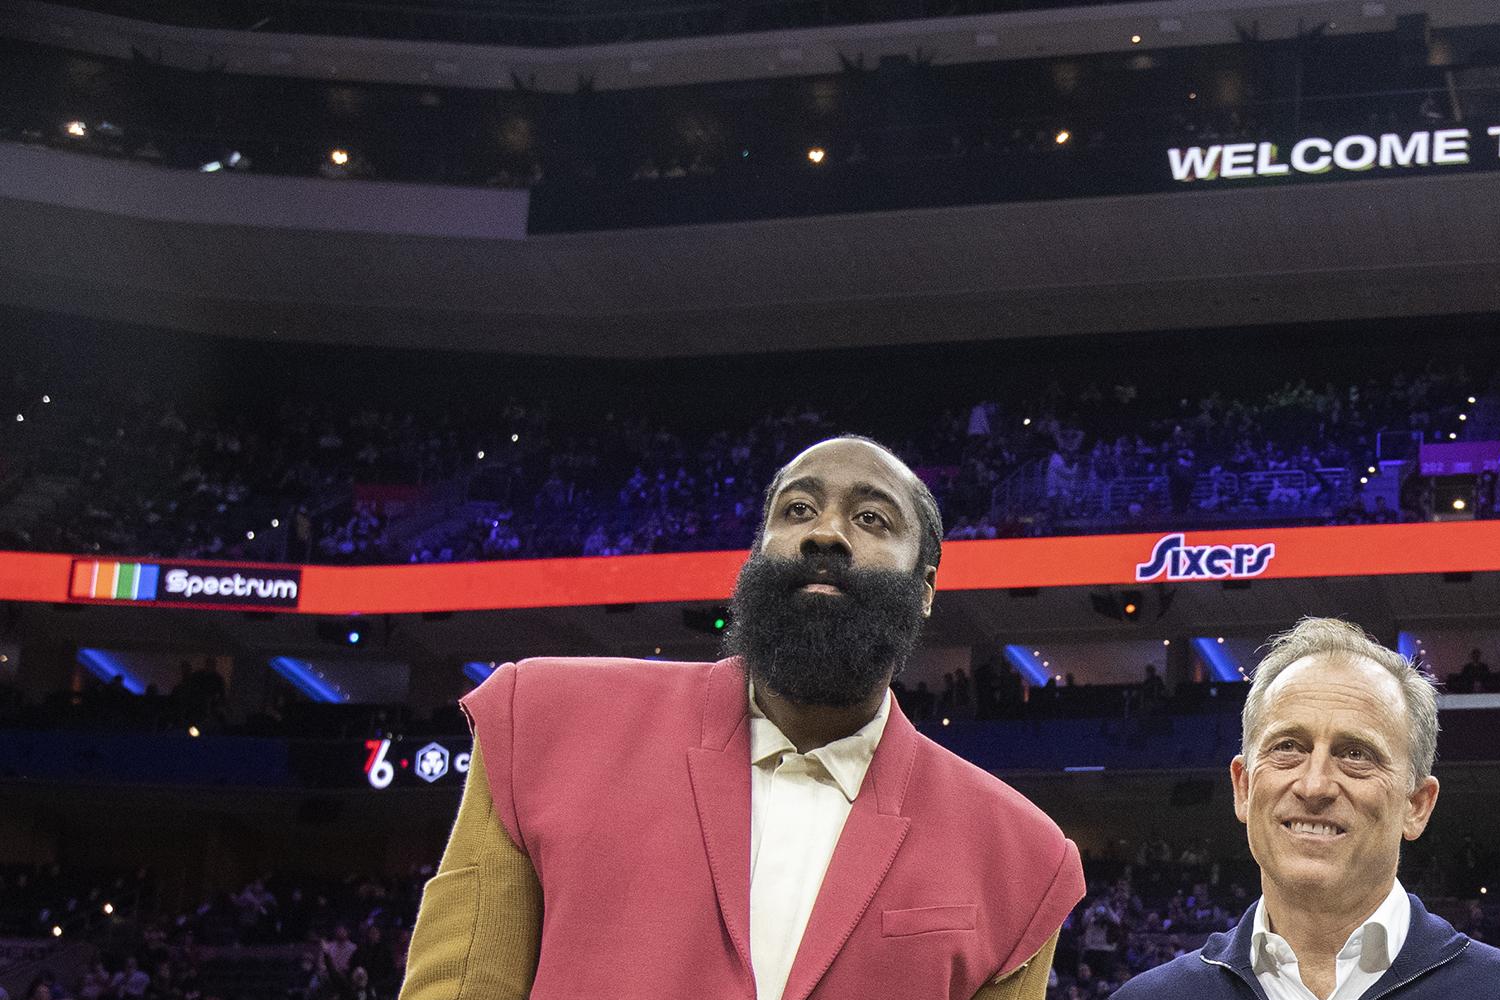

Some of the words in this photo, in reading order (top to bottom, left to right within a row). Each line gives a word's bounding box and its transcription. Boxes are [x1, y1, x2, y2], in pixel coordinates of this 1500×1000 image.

[1168, 129, 1471, 181] WELCOME
[1135, 533, 1276, 582] Sixers
[165, 569, 298, 599] Spectrum
[364, 739, 394, 789] 76
